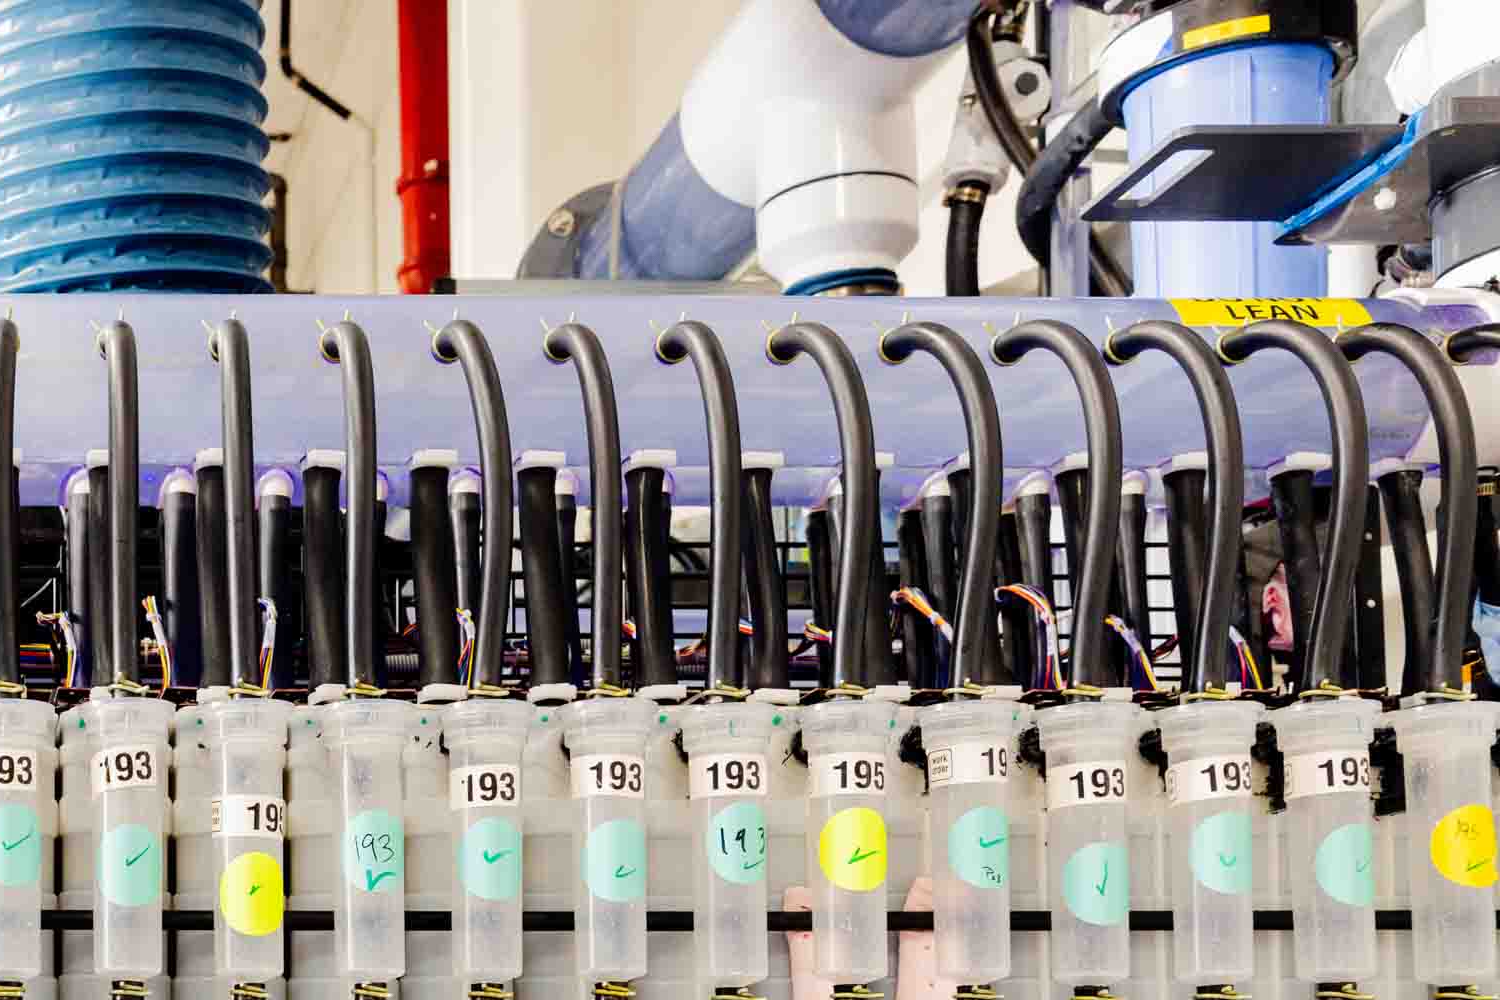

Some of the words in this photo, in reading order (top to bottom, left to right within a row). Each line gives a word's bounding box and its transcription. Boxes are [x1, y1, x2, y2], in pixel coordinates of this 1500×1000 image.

[1226, 304, 1319, 320] LEAN
[100, 751, 152, 784] 193
[589, 761, 642, 792] 193
[706, 760, 761, 790] 193
[833, 760, 885, 789] 195
[1200, 762, 1252, 792] 193
[1318, 757, 1370, 787] 193
[461, 772, 516, 802] 193
[1069, 768, 1124, 799] 193
[247, 802, 284, 834] 19
[353, 833, 396, 863] 193
